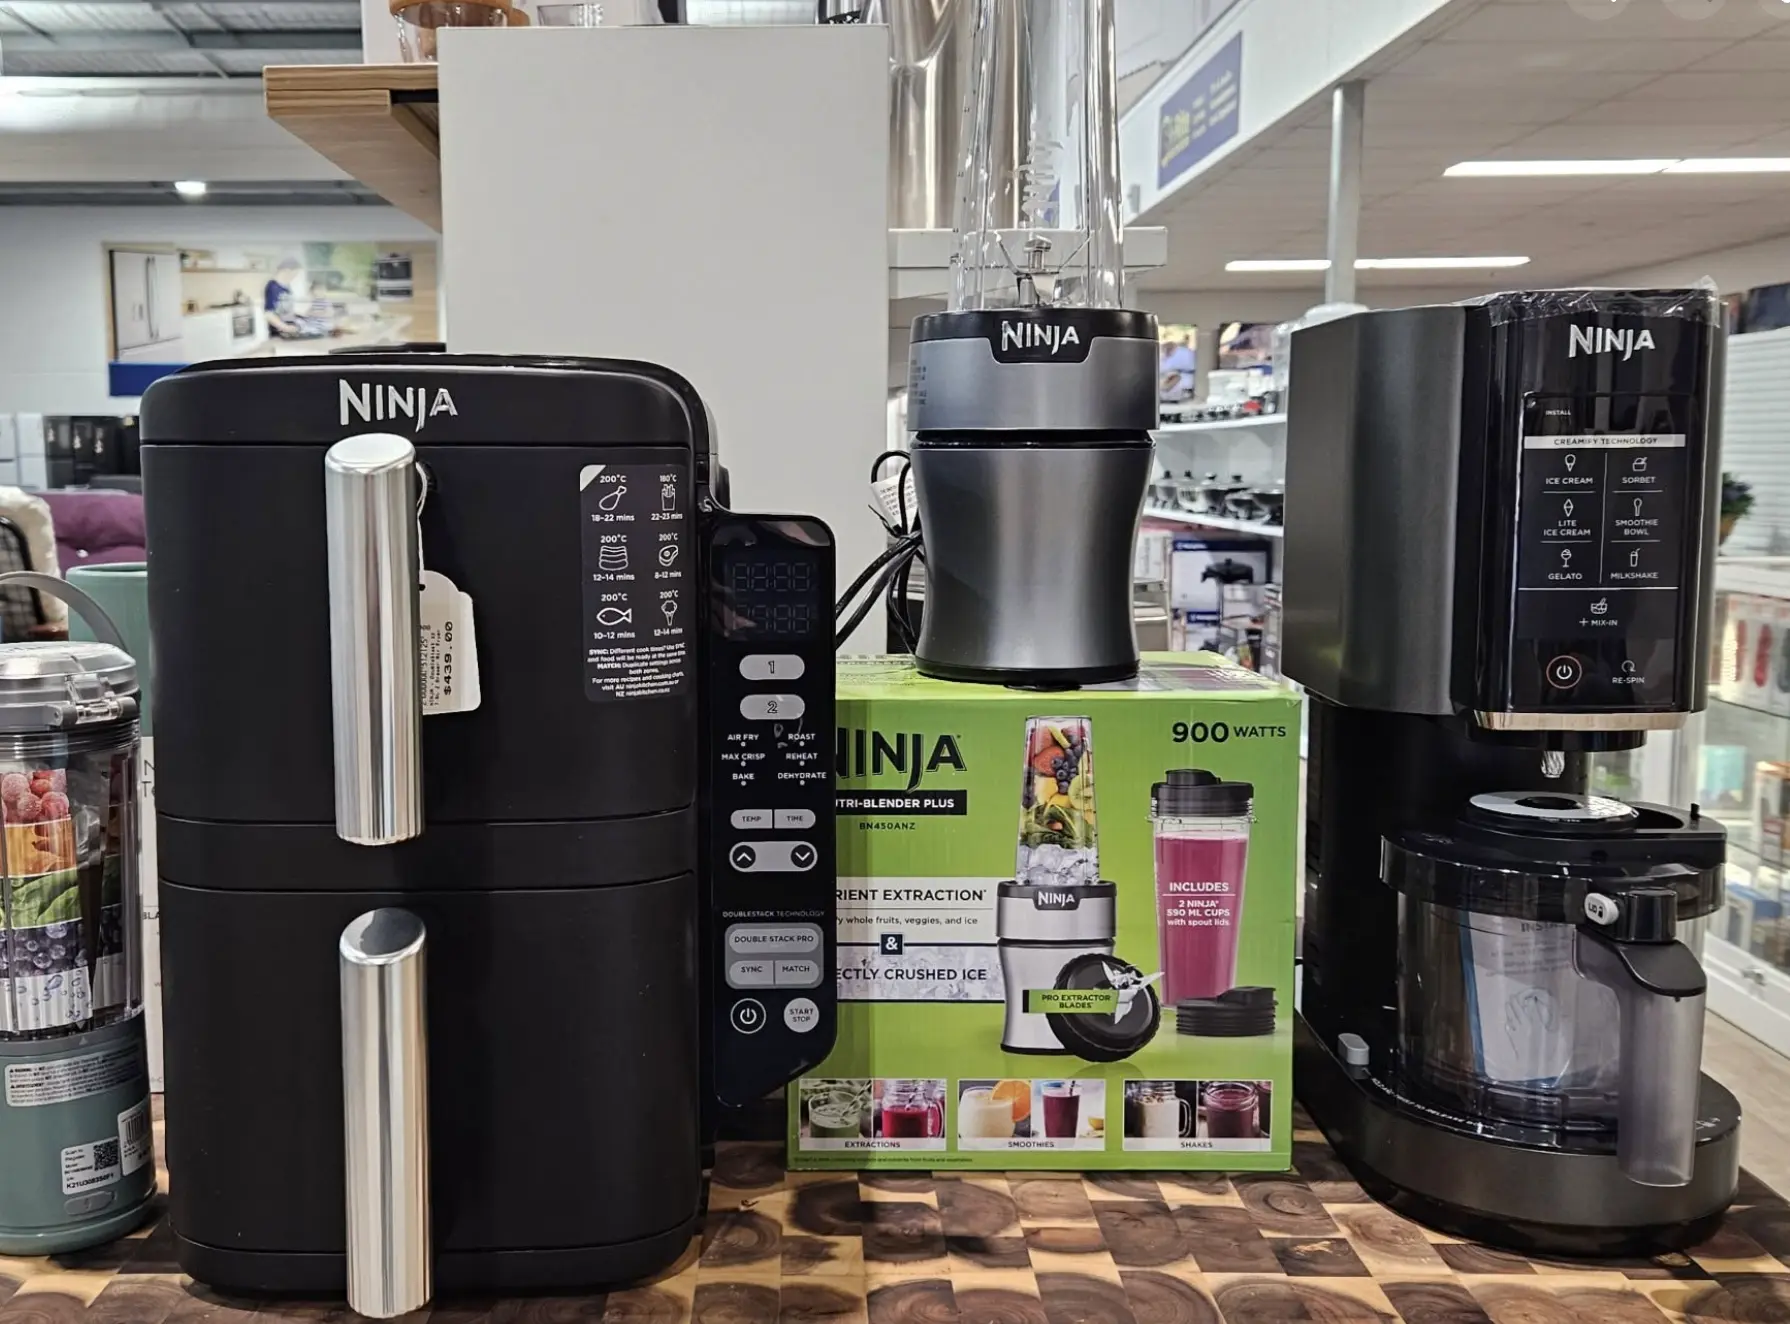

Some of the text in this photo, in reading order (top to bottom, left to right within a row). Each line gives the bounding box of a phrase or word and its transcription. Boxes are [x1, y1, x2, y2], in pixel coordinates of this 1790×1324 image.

[1002, 320, 1080, 355] NINJA
[1568, 323, 1656, 362] NINJA
[339, 378, 458, 433] NINJA
[1554, 438, 1598, 446] CREAMIFY
[600, 474, 627, 483] 200°C
[1545, 477, 1594, 485] ICE CREAM
[1622, 476, 1656, 484] SORBET
[590, 514, 636, 522] 18-22 mins
[1615, 518, 1660, 526] SMOOTHIE
[1624, 528, 1650, 536] BOWL
[600, 534, 628, 543] 200°C
[658, 533, 679, 542] 200°C
[592, 573, 636, 582] 12-14 mins
[1548, 572, 1583, 580] GELATO
[1610, 572, 1660, 580] MILKSHAKE
[600, 592, 628, 602] 200°C
[660, 590, 678, 600] 200°C
[593, 631, 615, 640] 10-12
[444, 622, 452, 696] $439.00
[768, 660, 776, 674] 1
[1612, 676, 1646, 684] RE-SPIN
[767, 700, 778, 714] 2
[1172, 722, 1287, 743] 900 WATTS
[741, 752, 766, 760] CRISP
[786, 752, 818, 760] REHEAT
[924, 798, 954, 808] PLUS
[859, 822, 916, 830] BN450ANZ
[1169, 882, 1230, 892] INCLUDES
[1038, 890, 1076, 908] NINJA
[1178, 900, 1185, 908] 2
[722, 910, 825, 918] DOUBLESTACK TECHNOLOGY
[1166, 909, 1230, 918] 590 ML CUPS
[842, 916, 874, 925] whole
[876, 916, 902, 925] fruits,
[904, 916, 942, 926] veggies,
[944, 916, 962, 925] and
[964, 916, 978, 925] ice
[1166, 918, 1186, 926] with
[1188, 918, 1213, 928] spout
[734, 935, 768, 943] DOUBLE
[885, 936, 899, 951] &
[884, 968, 958, 980] CRUSHED
[962, 968, 987, 980] ICE
[1042, 994, 1111, 1002] PRO EXTRACTOR
[789, 1008, 814, 1016] START
[844, 1140, 901, 1148] EXTRACTIONS
[1008, 1140, 1054, 1148] SMOOTHIES
